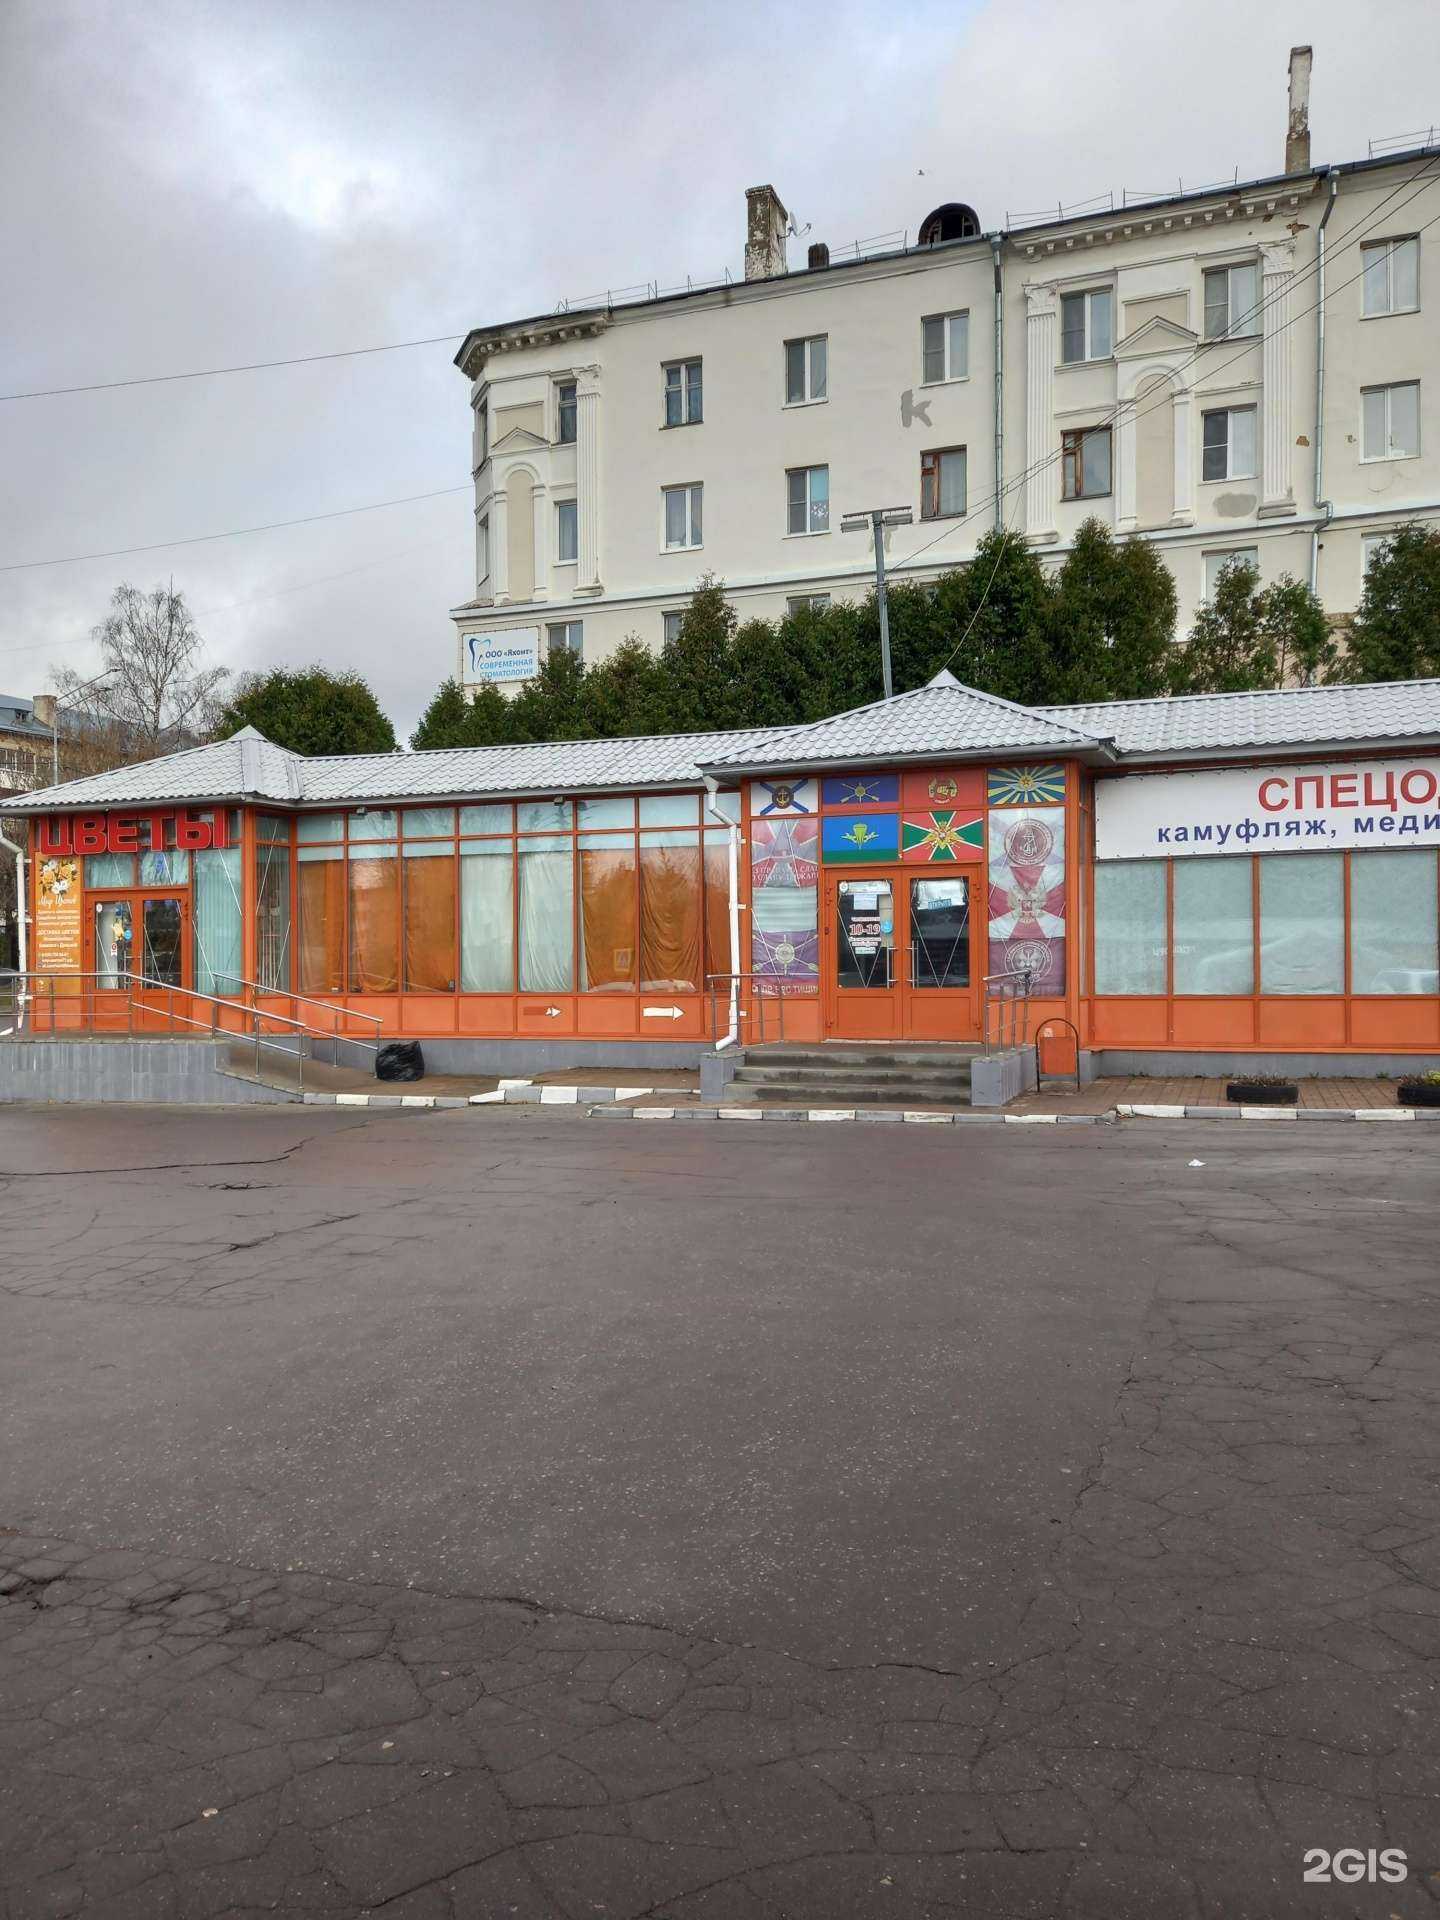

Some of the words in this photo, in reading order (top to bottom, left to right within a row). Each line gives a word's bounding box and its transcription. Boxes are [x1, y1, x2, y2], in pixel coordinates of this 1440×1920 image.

[480, 659, 533, 670] СОВРЕМЕННАЯ
[485, 650, 503, 658] ООО
[480, 669, 533, 678] СТОМАТОЛОГИЯ
[1258, 769, 1440, 812] СПЕЦО
[40, 808, 227, 856] ЦВЕТЫ
[1158, 818, 1337, 846] камуфляж,
[1354, 814, 1440, 834] меди
